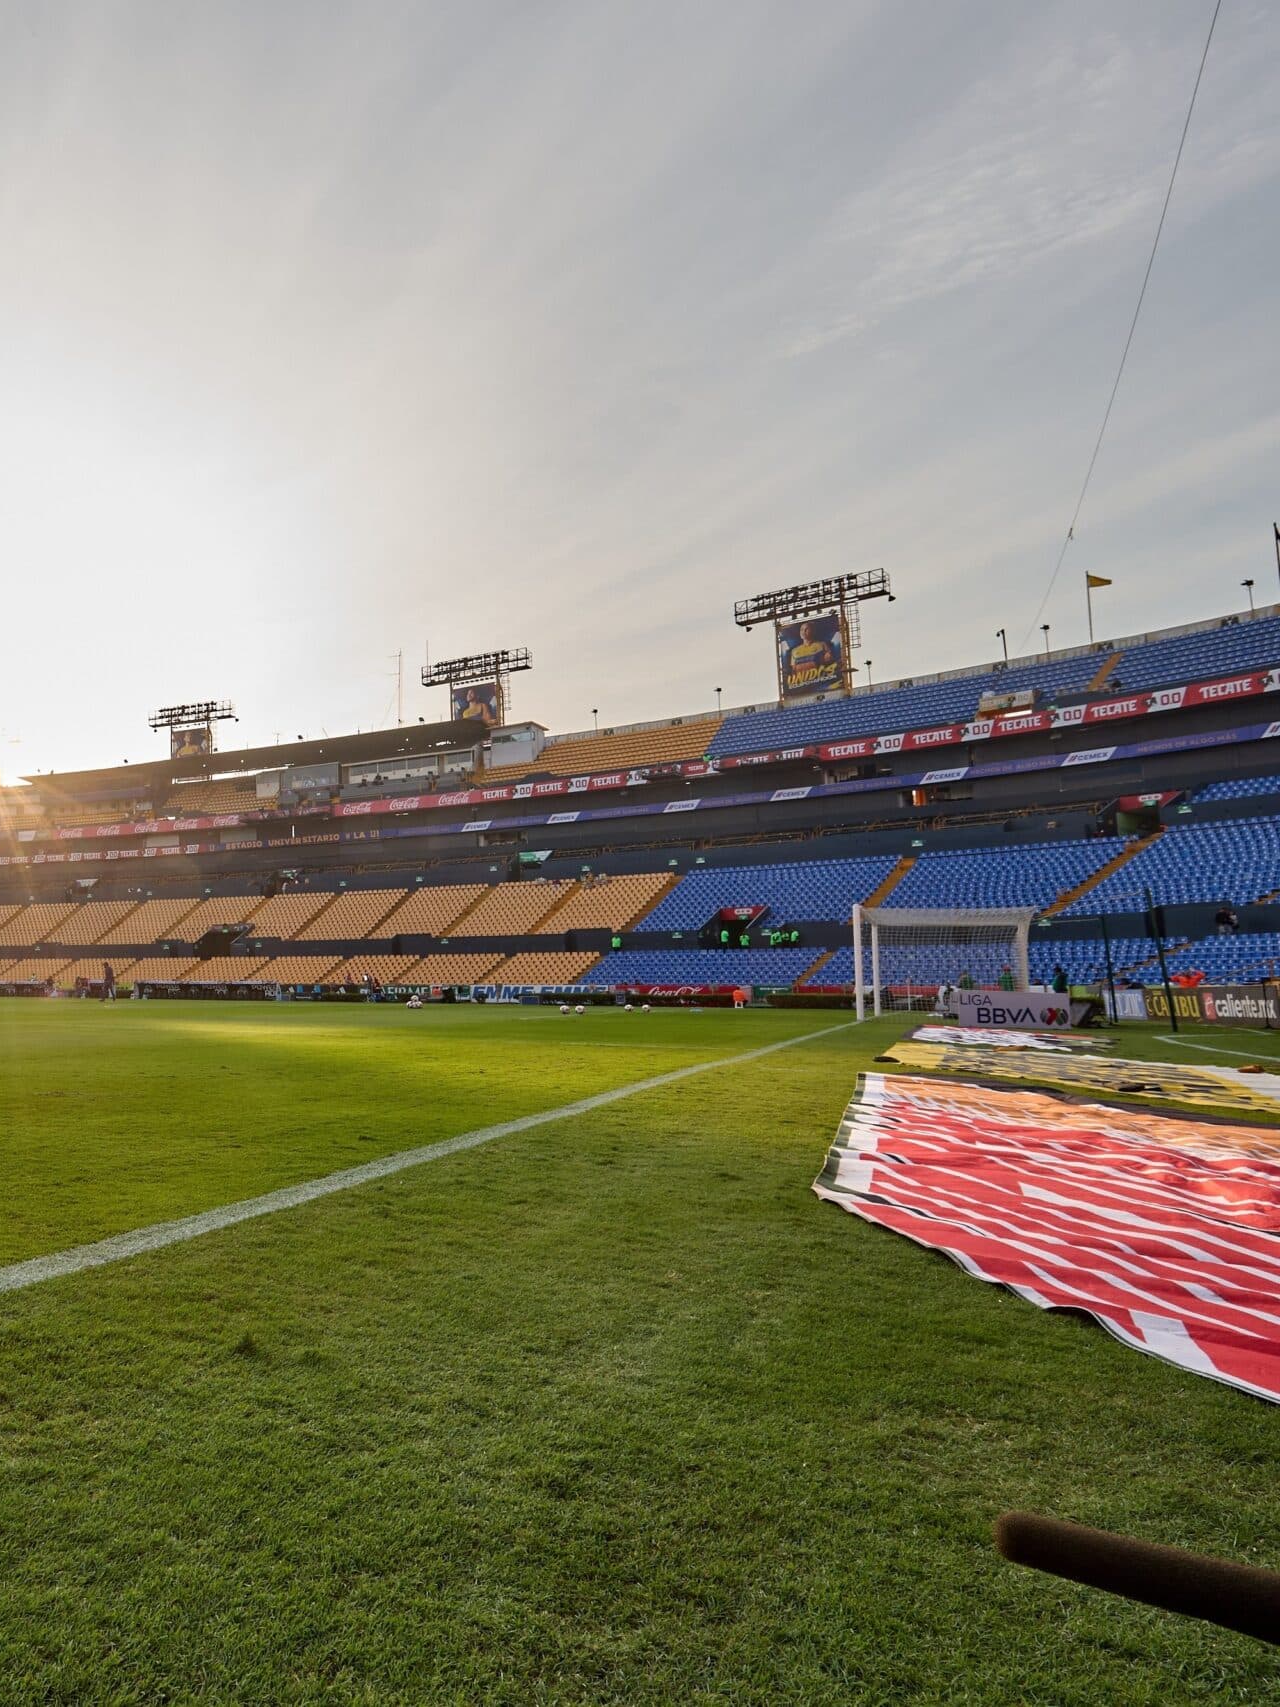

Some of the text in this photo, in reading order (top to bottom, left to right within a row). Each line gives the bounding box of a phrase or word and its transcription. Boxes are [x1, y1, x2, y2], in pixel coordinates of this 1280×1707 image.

[828, 742, 866, 757] TECATE
[912, 729, 953, 745] TECATE
[998, 714, 1042, 732] TECATE
[1090, 700, 1138, 718] TECATE
[1199, 678, 1252, 699] TECATE
[1076, 751, 1109, 761] CEMEX
[934, 771, 962, 780] CEMEX
[343, 801, 372, 815] Coca-Cola
[390, 797, 420, 811] Coca-Cola
[438, 791, 470, 806] Coca-Cola
[482, 788, 508, 799] TECATE
[535, 782, 563, 793] TECATE
[592, 775, 621, 787] TECATE
[225, 840, 263, 850] ESTADIO
[268, 833, 340, 847] UNIVERSITARIO
[960, 994, 993, 1006] LIGA
[977, 1007, 1037, 1025] BBVA
